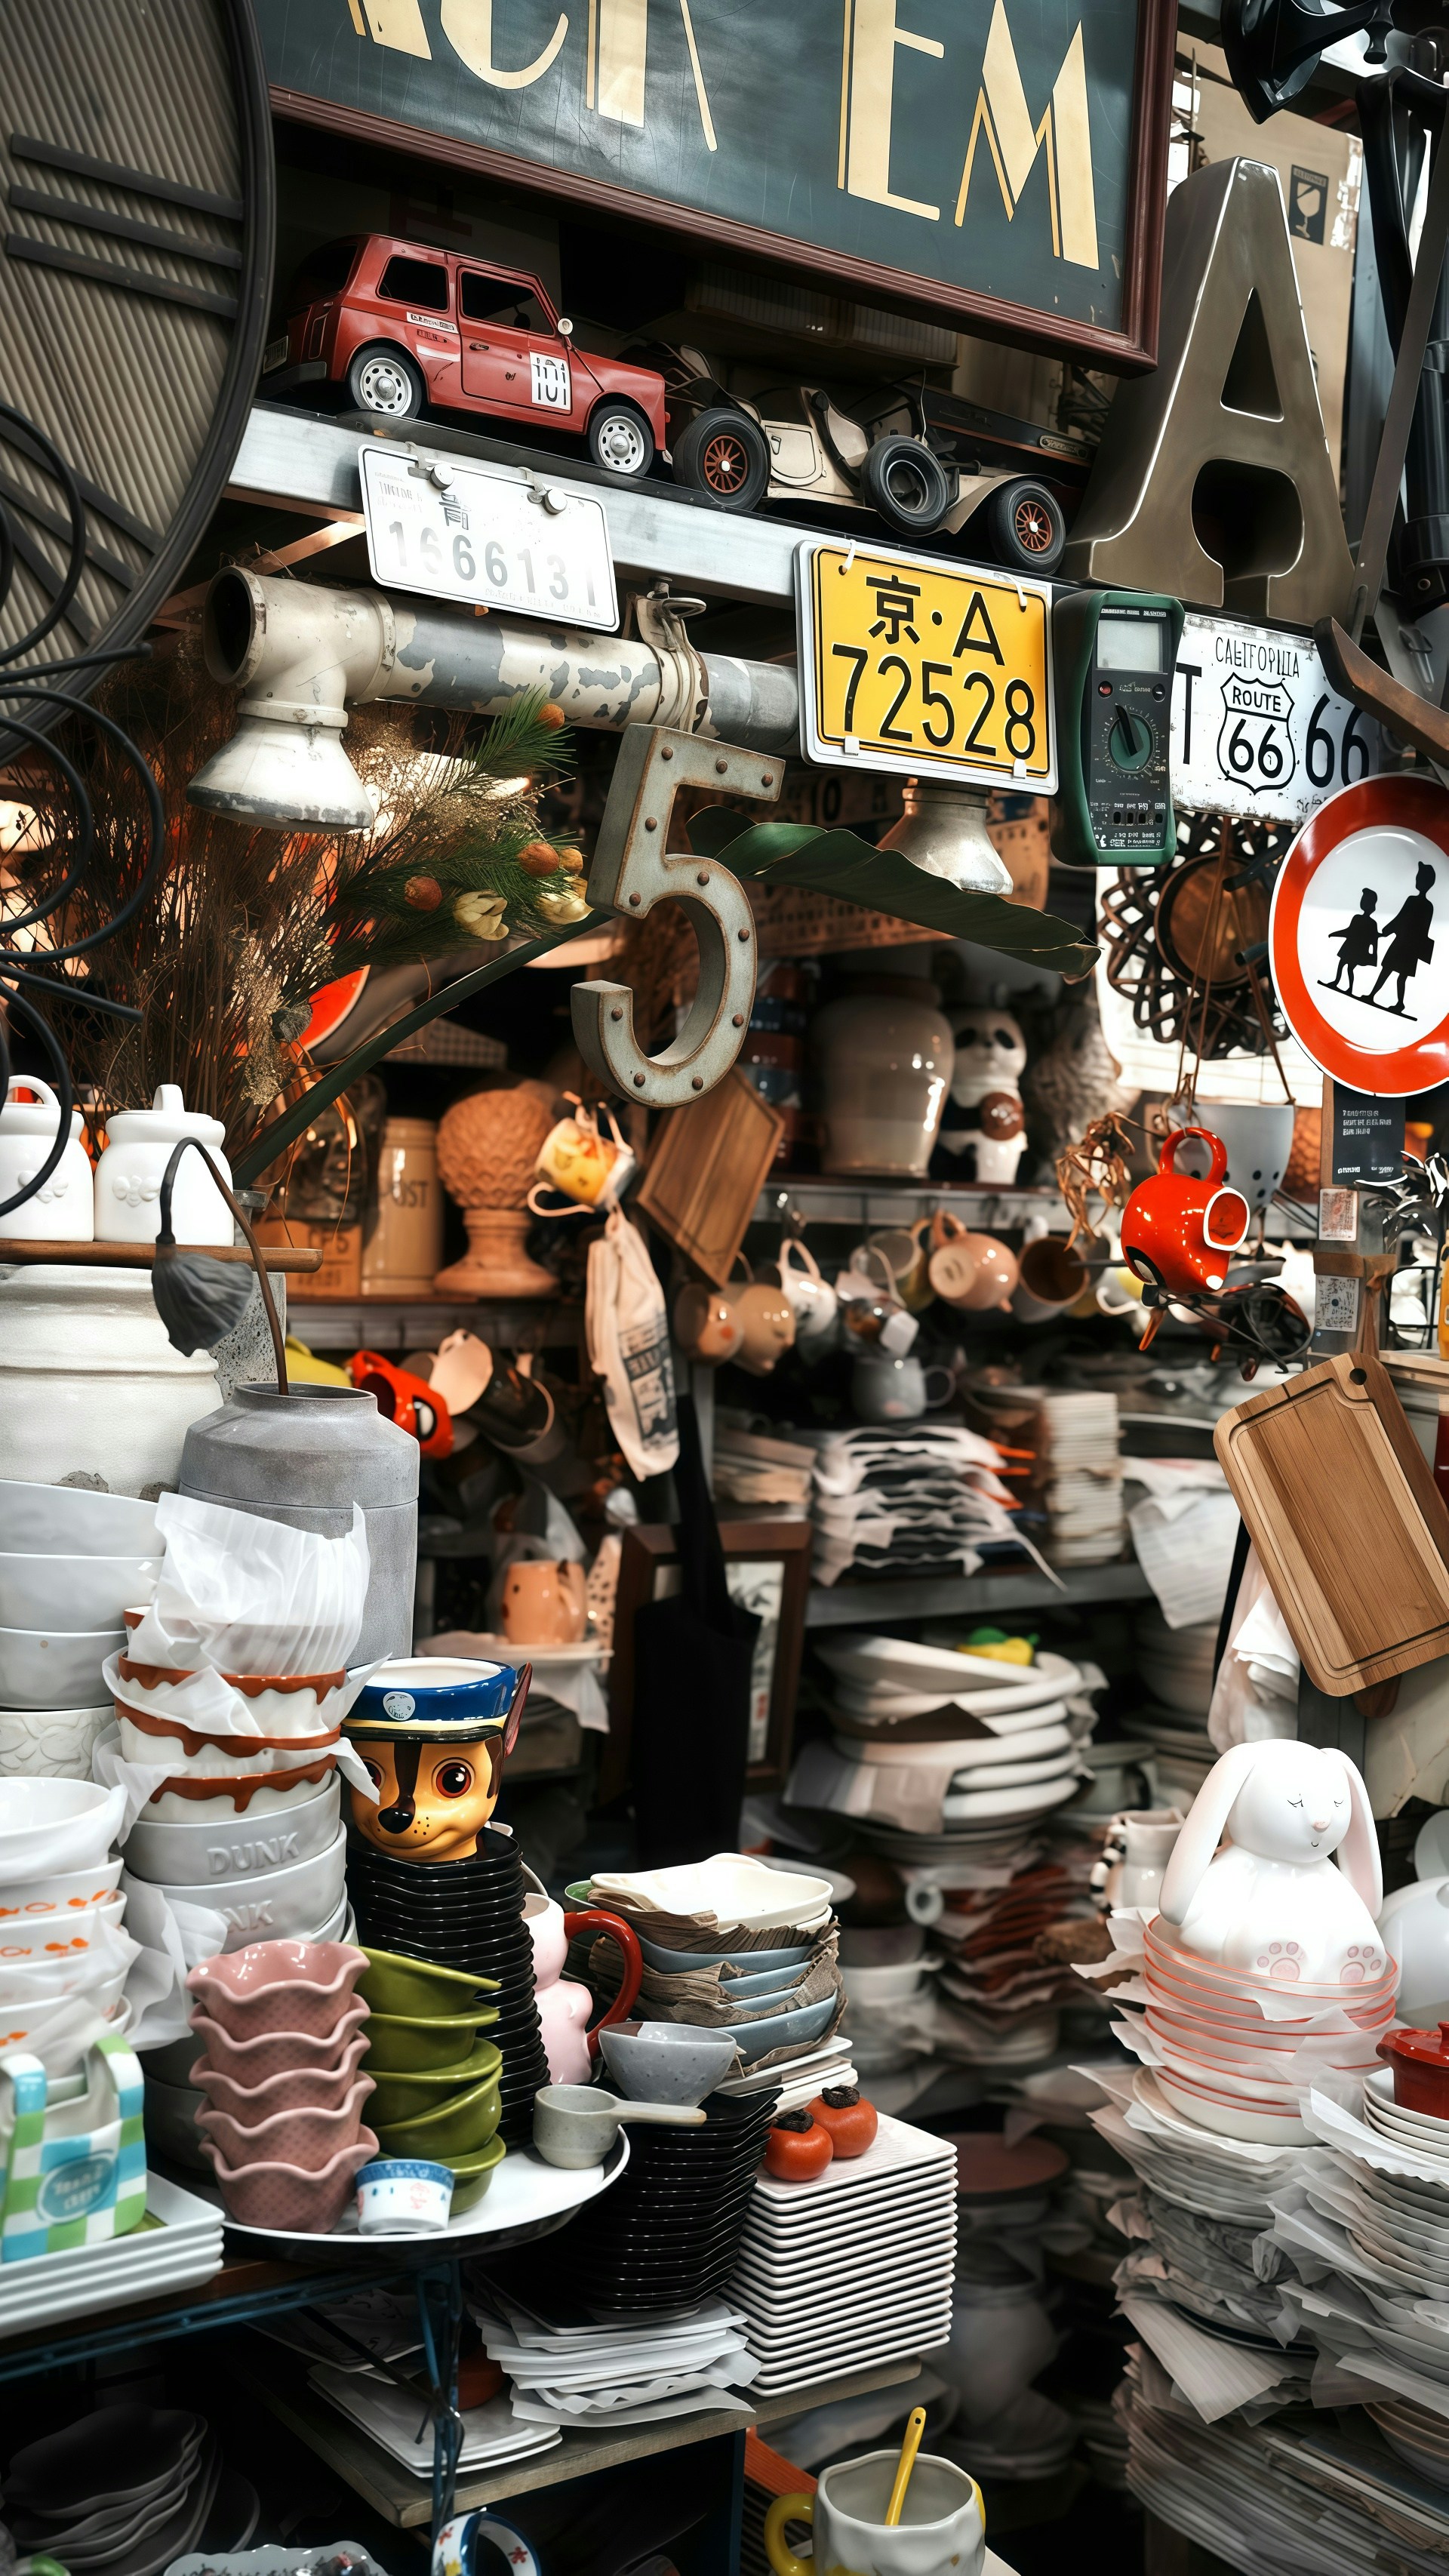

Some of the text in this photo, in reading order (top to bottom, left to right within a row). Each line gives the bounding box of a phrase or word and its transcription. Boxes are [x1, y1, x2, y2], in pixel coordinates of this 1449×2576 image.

[832, 643, 1035, 760] 72528
[1232, 685, 1281, 712] ROUTE
[1228, 719, 1284, 779] 66
[571, 723, 786, 1108] 5
[206, 1831, 300, 1876] DUNK
[213, 1899, 274, 1934] NK
